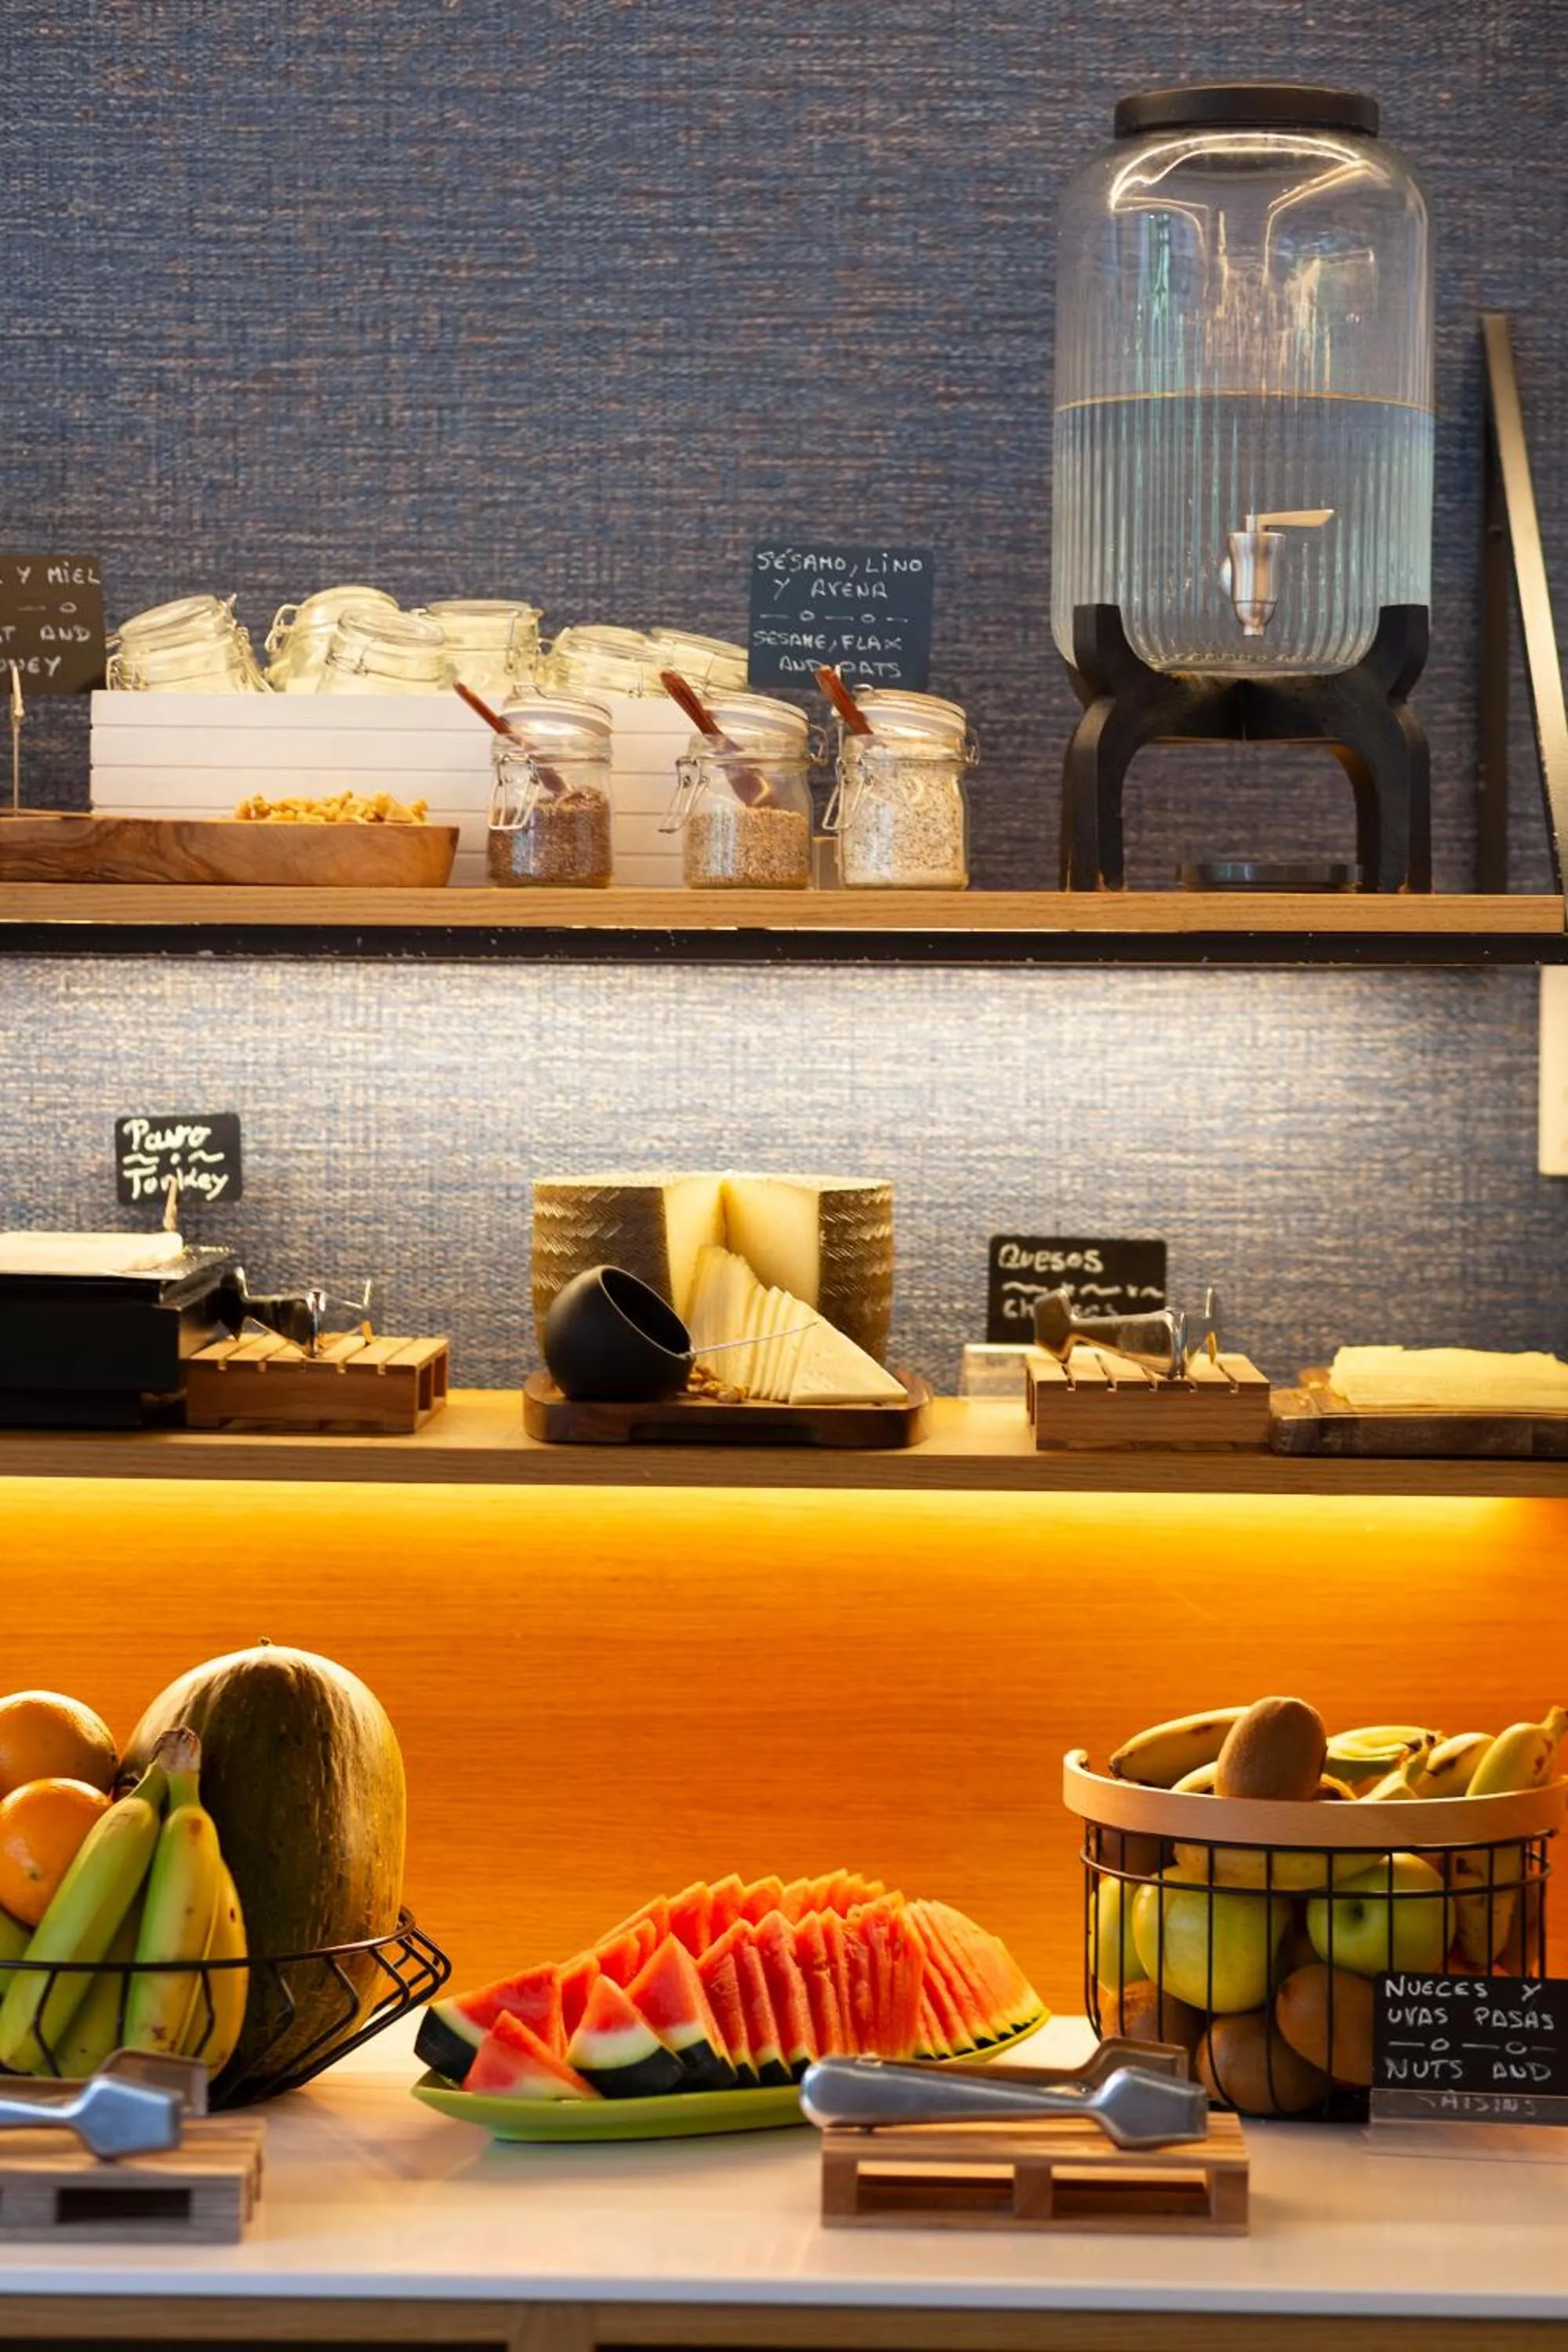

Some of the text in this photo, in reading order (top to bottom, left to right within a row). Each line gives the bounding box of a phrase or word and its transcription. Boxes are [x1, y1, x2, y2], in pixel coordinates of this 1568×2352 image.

[16, 566, 31, 584] Y
[773, 578, 790, 601] Y
[40, 624, 90, 642] AND
[841, 634, 902, 651] FLAX
[839, 661, 901, 678] OATS
[998, 1243, 1104, 1273] Quesos
[1385, 1975, 1541, 2001] NUECES Y
[1387, 2006, 1555, 2031] UVAS PASAS
[1385, 2057, 1464, 2079] NUTS
